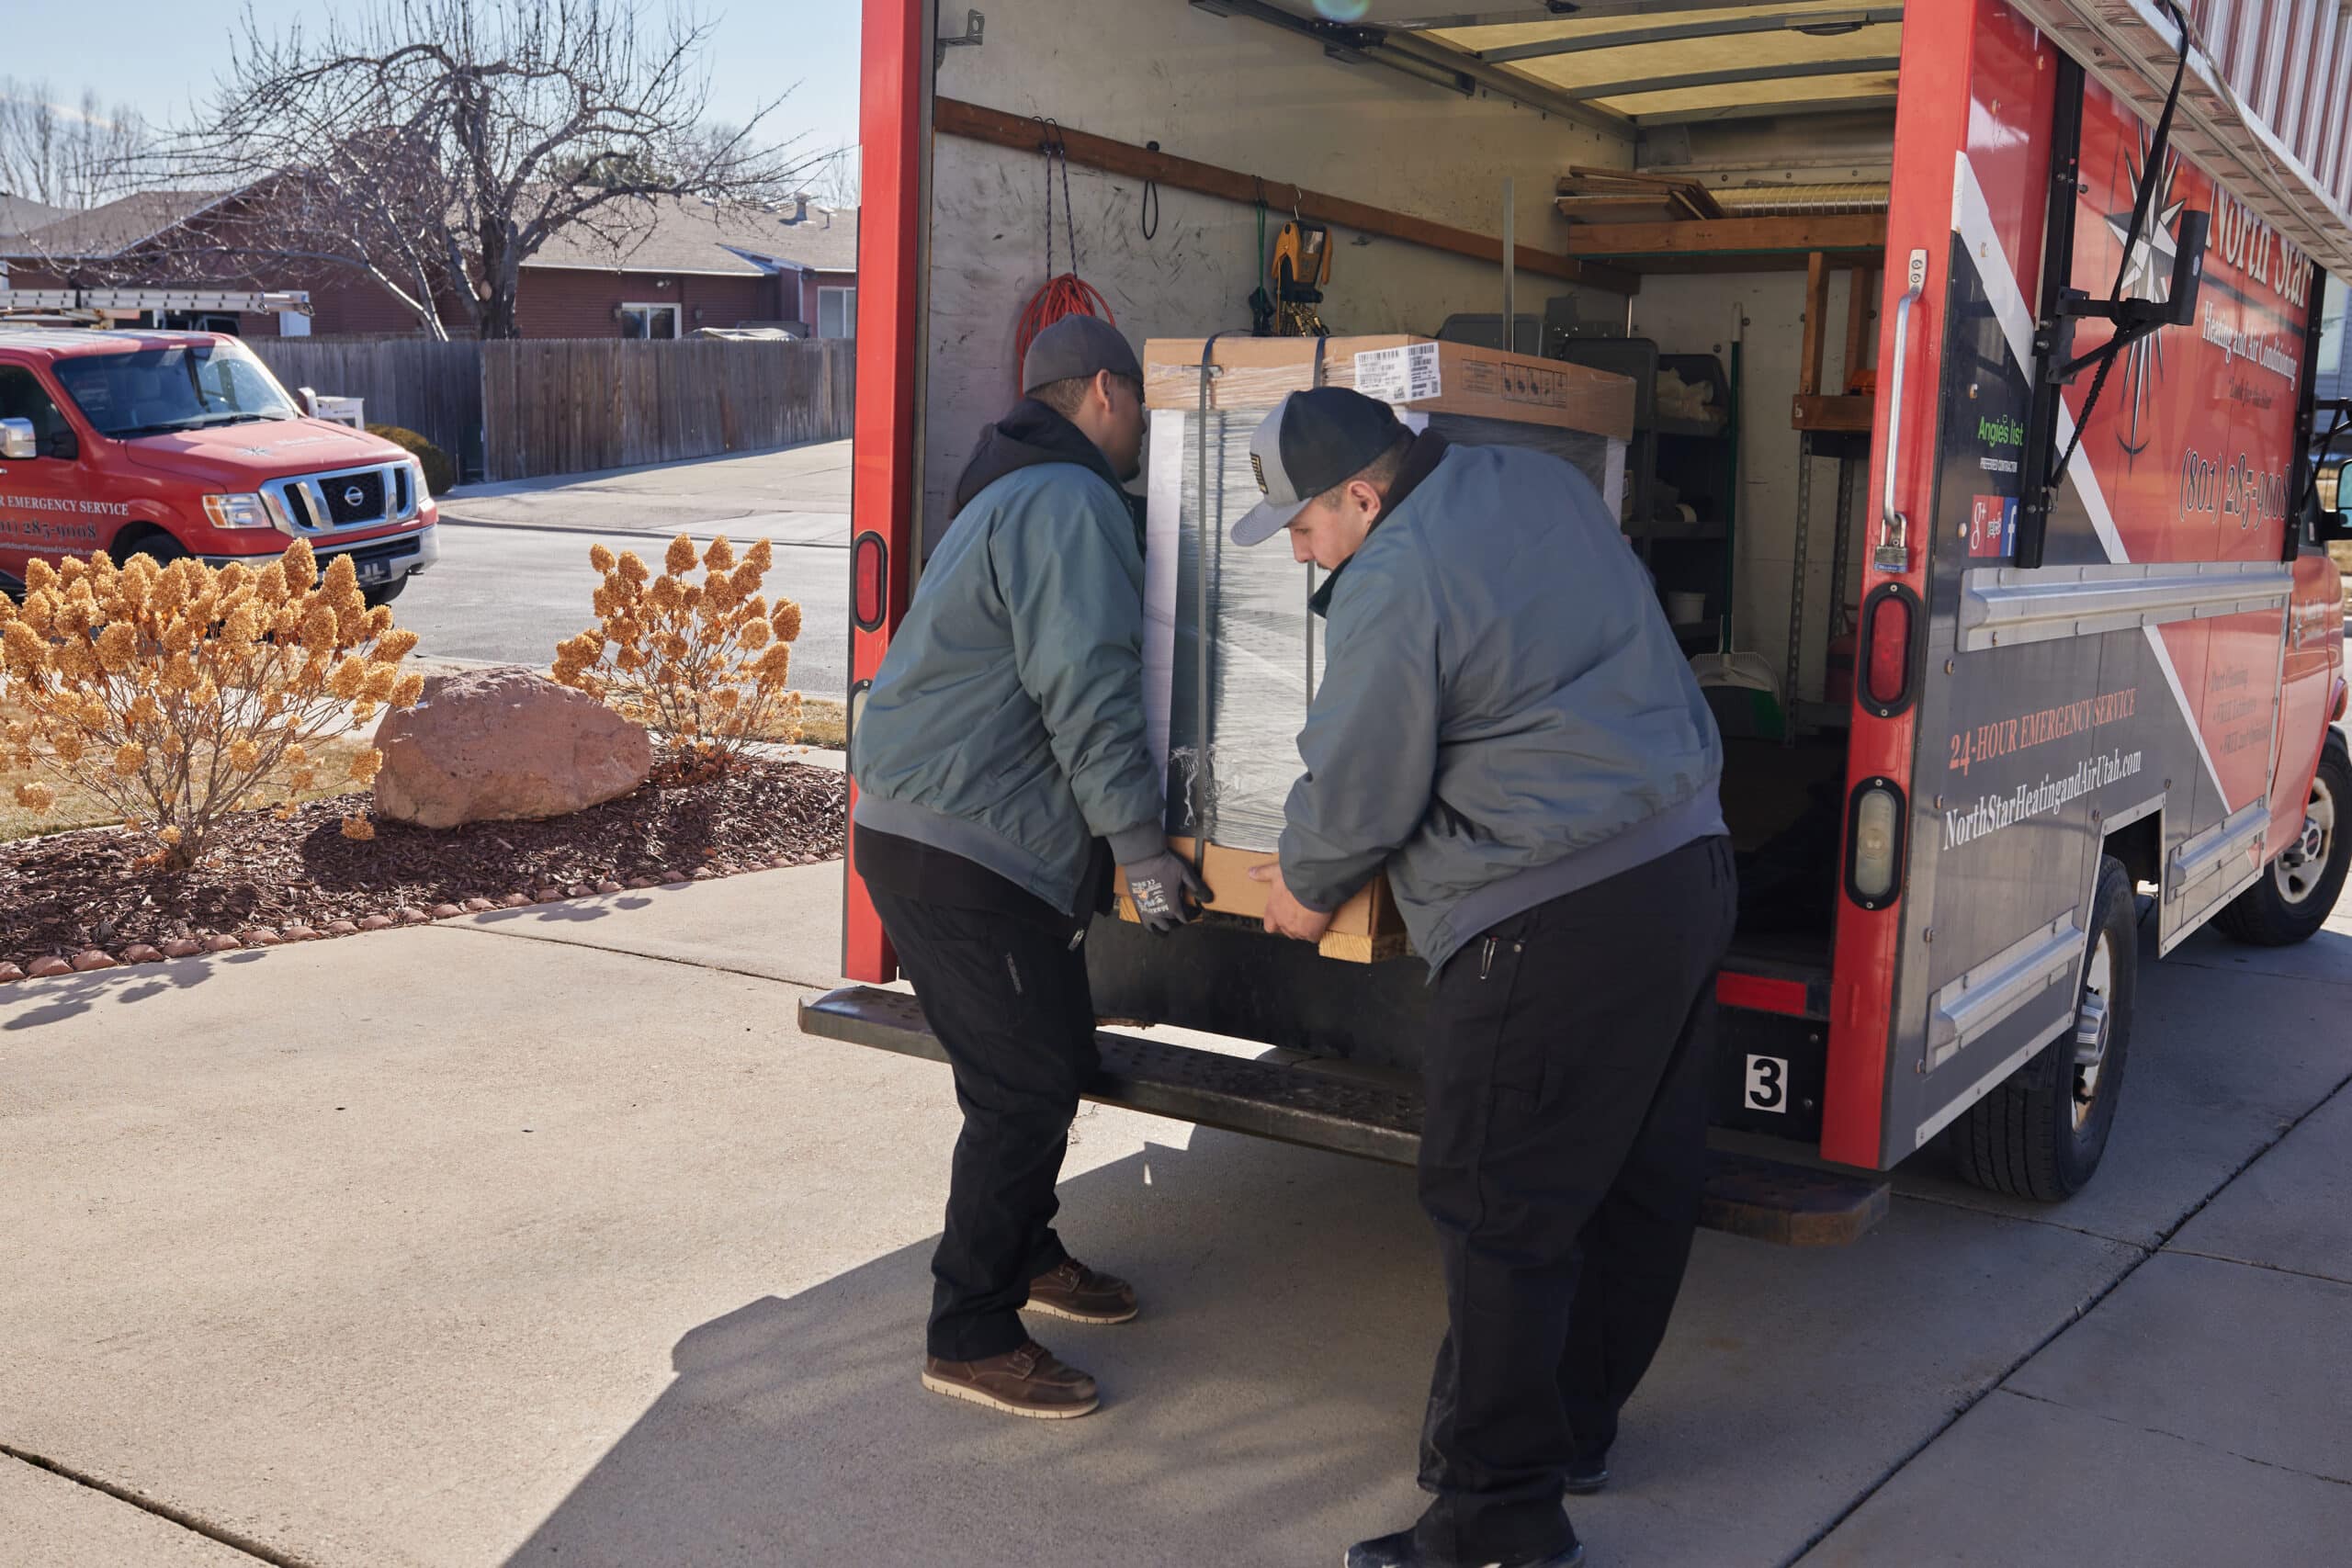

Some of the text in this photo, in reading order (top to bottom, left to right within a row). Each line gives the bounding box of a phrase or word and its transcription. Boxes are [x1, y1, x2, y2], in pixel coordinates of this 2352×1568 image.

[2274, 235, 2314, 309] Star
[2202, 300, 2233, 365] Heating
[2233, 319, 2248, 357] and
[2009, 418, 2024, 446] list
[7, 495, 77, 513] EMERGENCY
[79, 500, 129, 515] SERVICE
[2179, 447, 2292, 531] (801) 285-9008
[23, 518, 96, 541] 285-9008
[1948, 688, 2137, 777] 24-HOUR EMERGENCY SERVICE
[1943, 748, 2143, 851] NorthStarHeatingandAirUtah.com
[1749, 1057, 1782, 1108] 3
